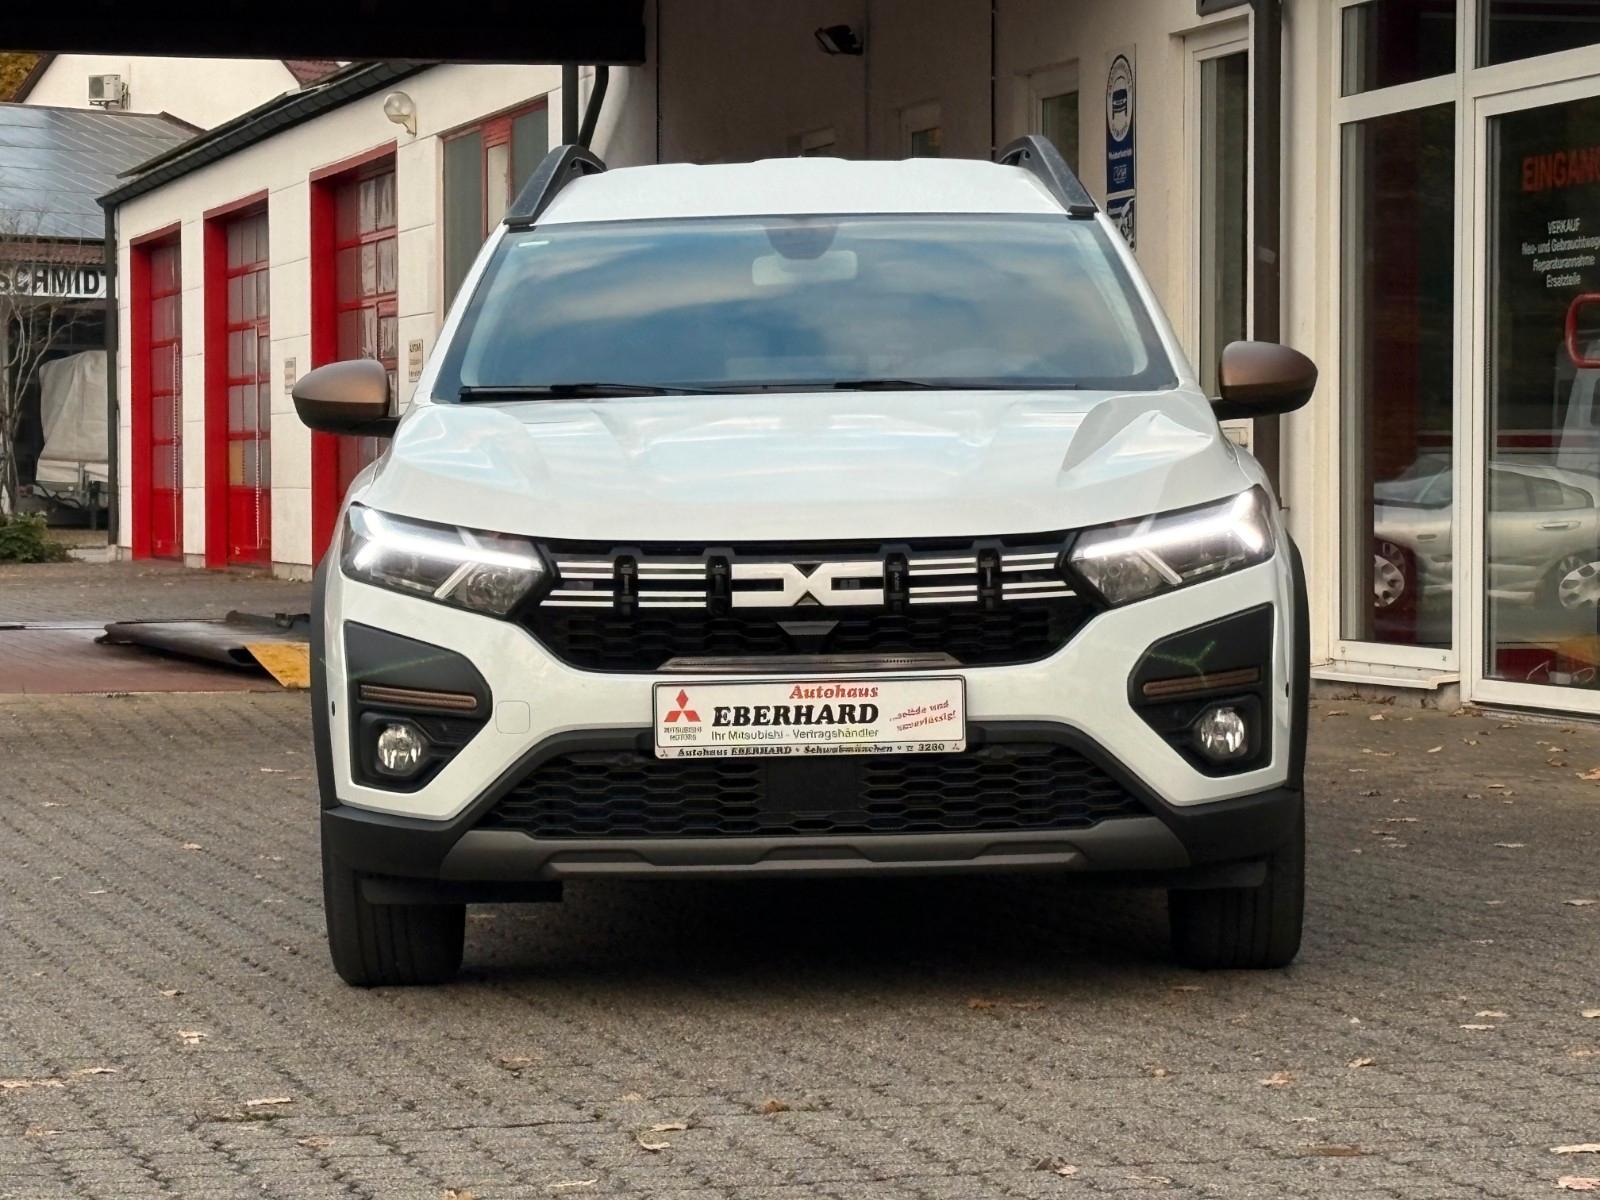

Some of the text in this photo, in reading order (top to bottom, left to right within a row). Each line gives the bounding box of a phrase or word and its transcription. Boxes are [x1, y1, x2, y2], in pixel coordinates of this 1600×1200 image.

[1547, 217, 1580, 234] VERKAUF
[1551, 235, 1600, 252] Gebrauchtwag
[0, 266, 107, 295] SCHMID
[1546, 272, 1582, 288] Ersatzteile
[789, 684, 879, 700] Autohaus
[712, 702, 879, 727] EBERHARD
[711, 729, 726, 741] Ihr
[728, 728, 784, 741] Mitsubishi
[677, 747, 728, 757] Autohaus
[731, 746, 792, 756] EBERHARD
